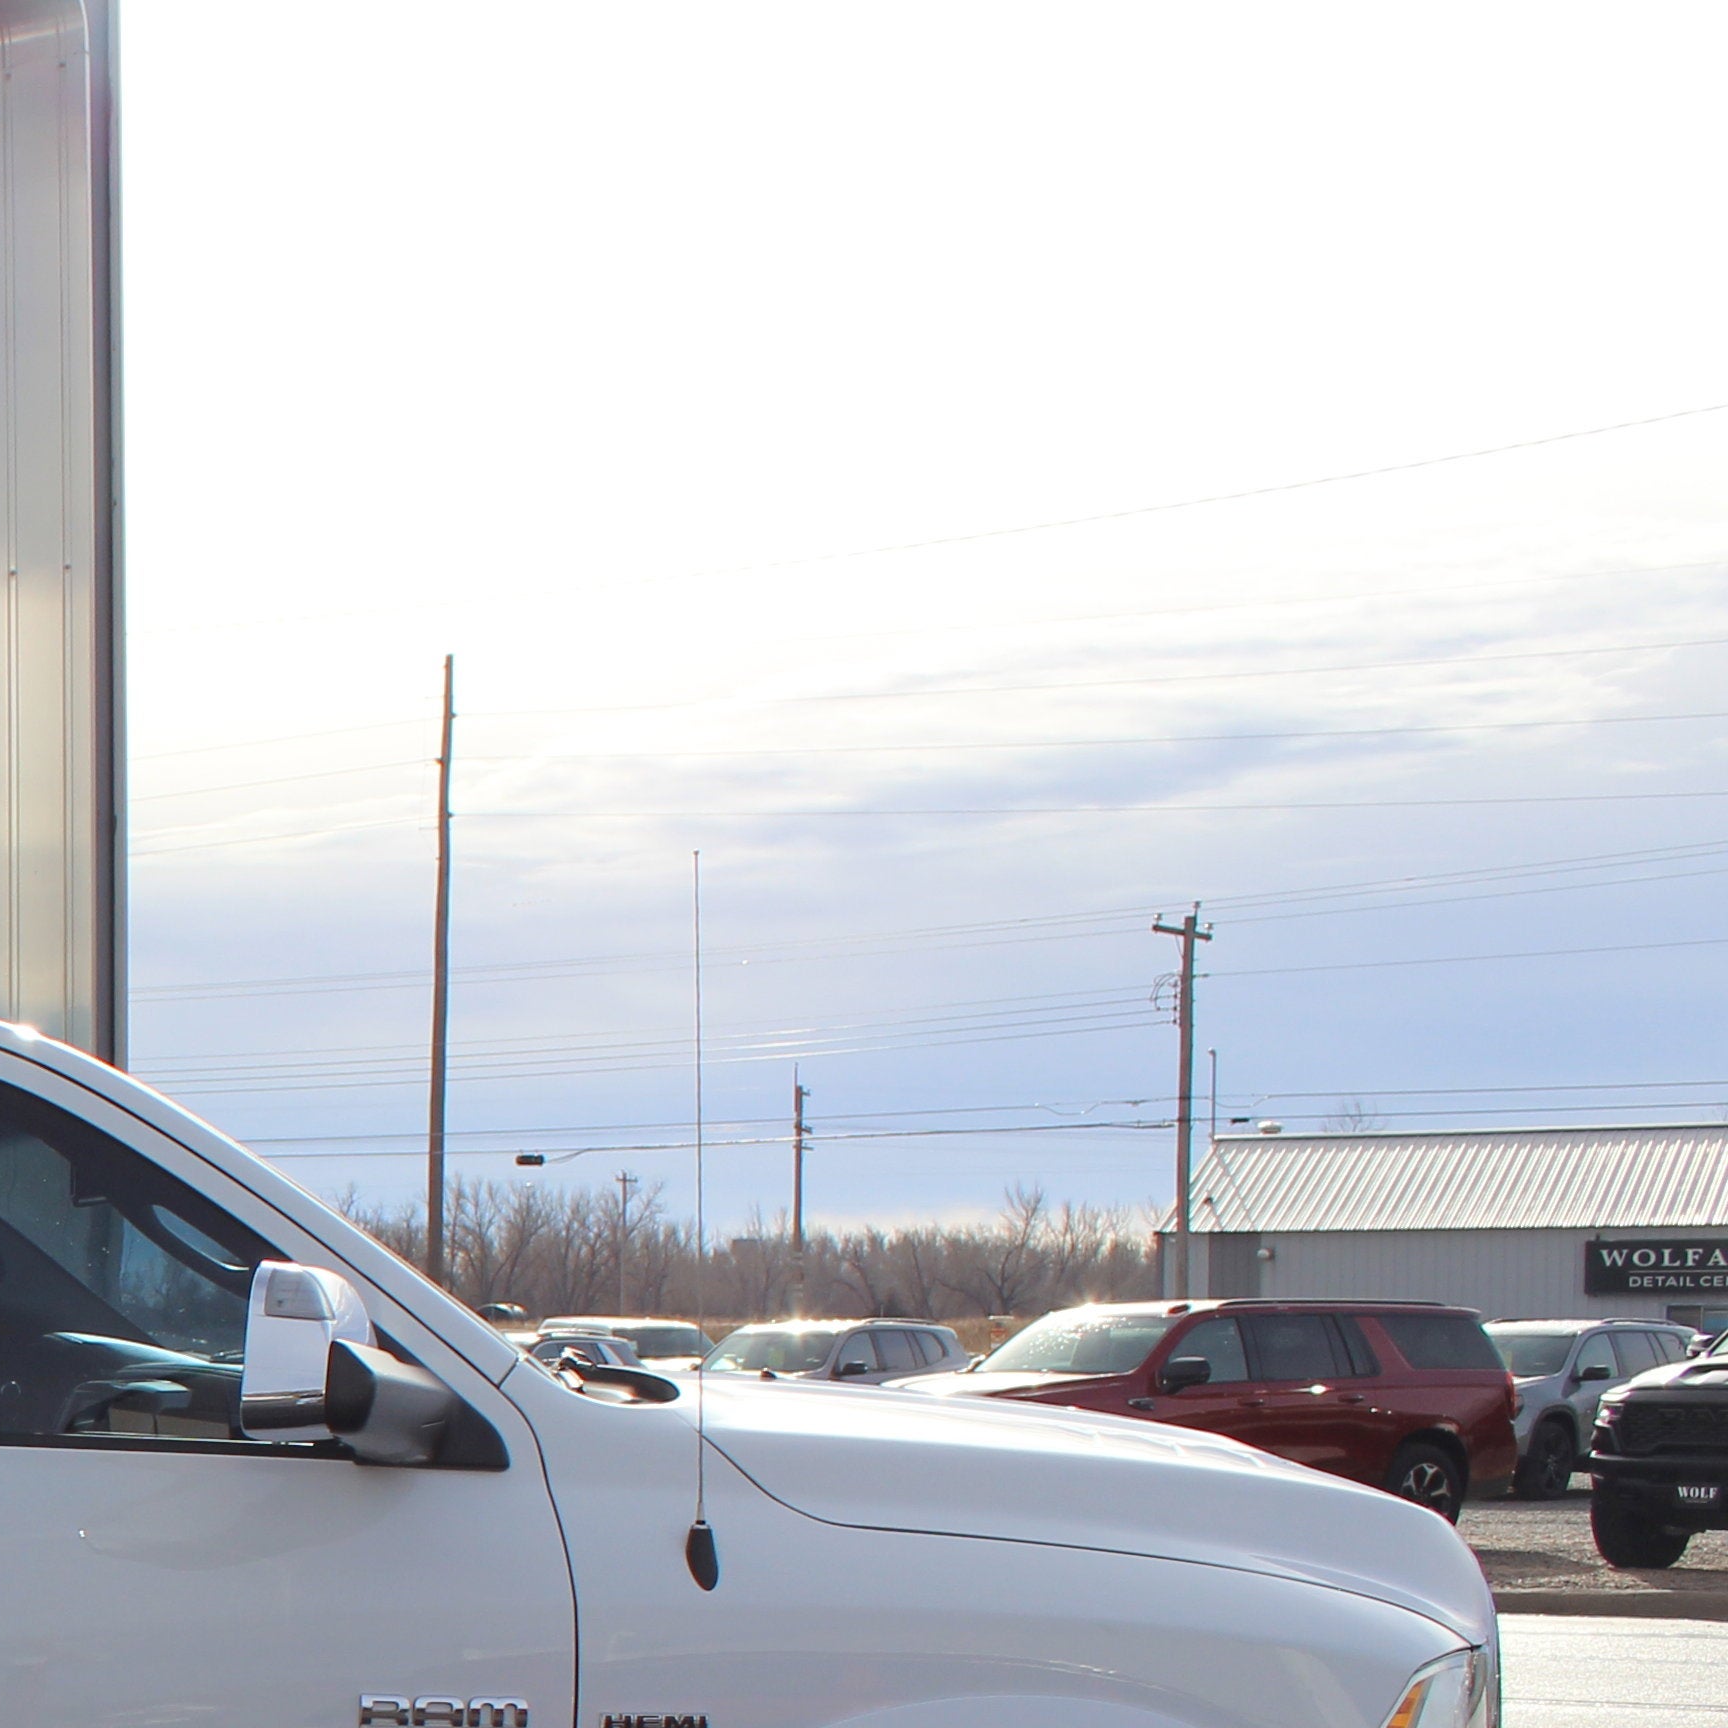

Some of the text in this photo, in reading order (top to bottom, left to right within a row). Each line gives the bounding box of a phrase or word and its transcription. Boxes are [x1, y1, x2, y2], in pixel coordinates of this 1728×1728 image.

[1600, 1248, 1728, 1267] WOLFA
[1628, 1276, 1728, 1288] DETAIL CE
[1677, 1486, 1718, 1499] WOLF
[360, 1694, 529, 1728] RAM
